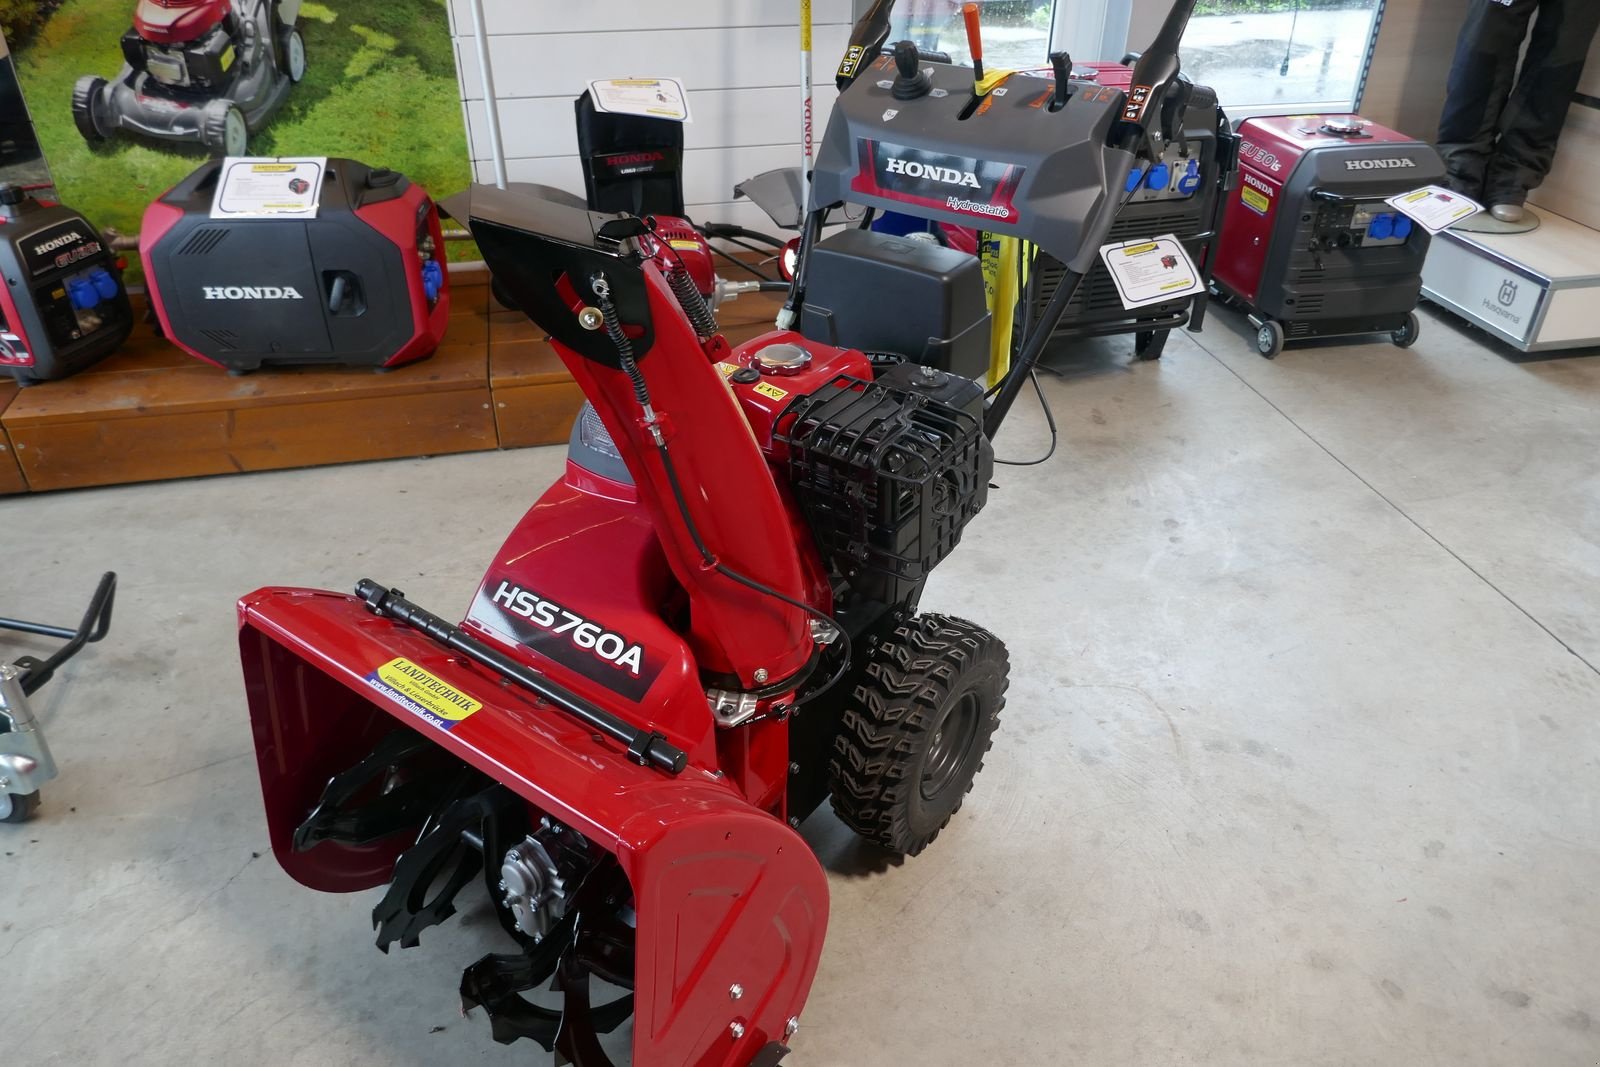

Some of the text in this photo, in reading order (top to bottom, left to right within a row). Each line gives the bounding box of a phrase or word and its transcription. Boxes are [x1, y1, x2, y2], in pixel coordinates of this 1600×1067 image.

[804, 96, 812, 156] HONDA
[607, 151, 664, 166] HONDA
[1344, 158, 1416, 170] HONDA
[886, 158, 981, 188] HONDA
[1244, 173, 1274, 197] HONDA
[946, 196, 1009, 218] Hydrostatic
[34, 232, 82, 255] HONDA
[202, 286, 304, 300] HONDA
[1482, 298, 1521, 324] Husqvarna
[493, 581, 642, 675] HSS760A
[385, 675, 404, 690] Villach
[409, 690, 448, 716] Lieserbrücke
[393, 660, 475, 711] LANDTECHNIK
[369, 678, 444, 727] www.landtechnik.co.at
